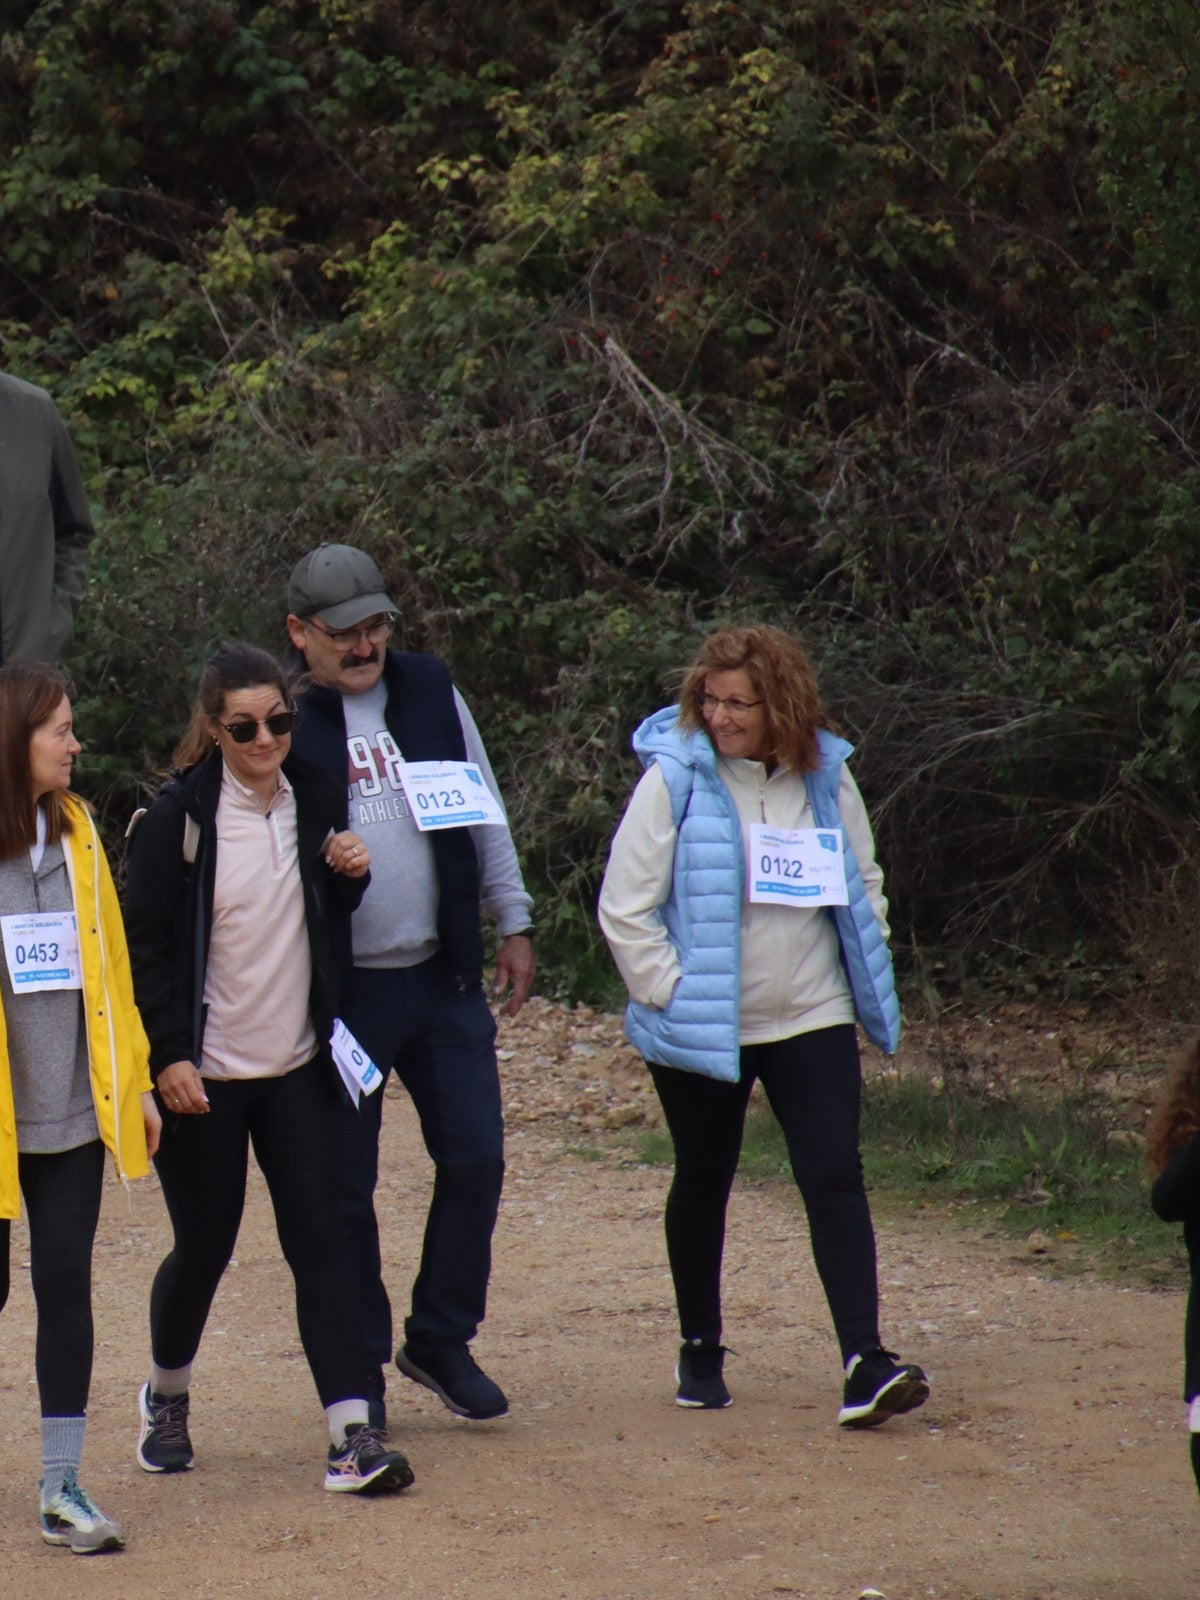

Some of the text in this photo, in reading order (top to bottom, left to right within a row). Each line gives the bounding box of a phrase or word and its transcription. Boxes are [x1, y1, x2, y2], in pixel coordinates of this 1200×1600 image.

[348, 730, 406, 799] 98
[416, 789, 466, 810] 0123
[761, 855, 803, 878] 0122
[15, 943, 59, 964] 0453
